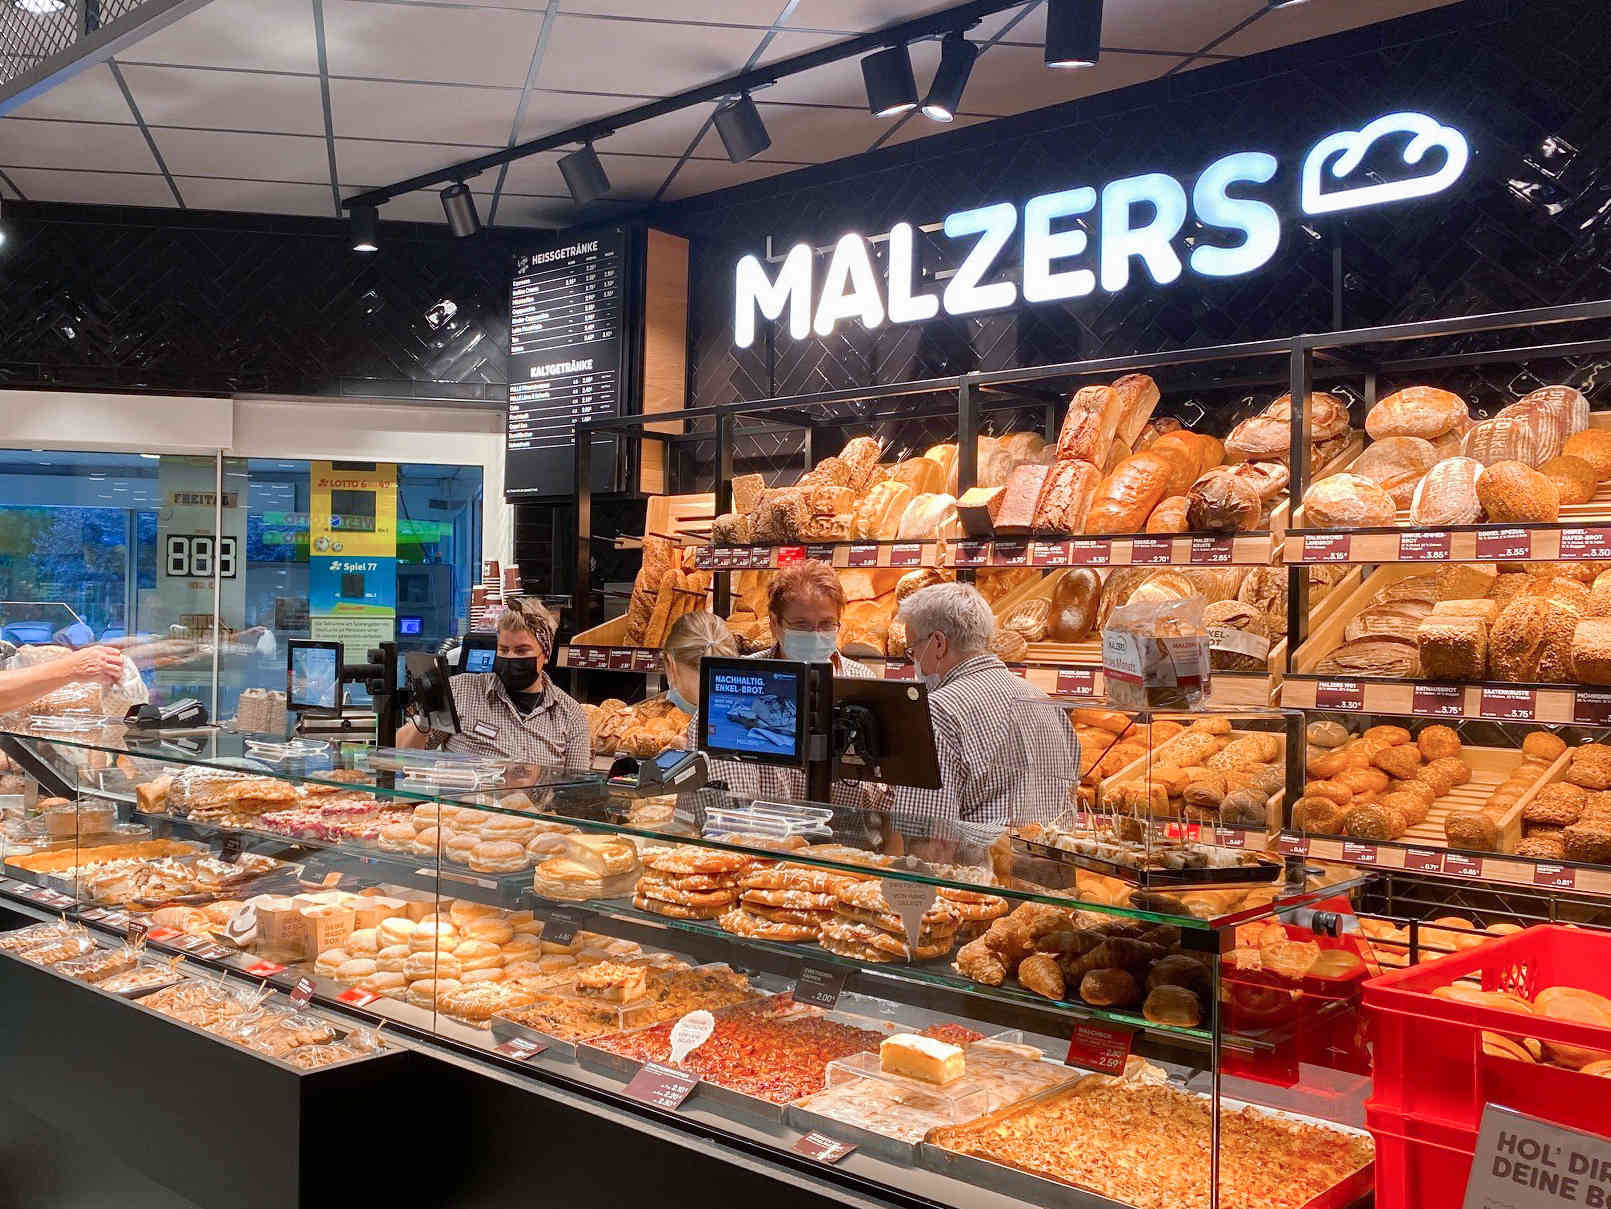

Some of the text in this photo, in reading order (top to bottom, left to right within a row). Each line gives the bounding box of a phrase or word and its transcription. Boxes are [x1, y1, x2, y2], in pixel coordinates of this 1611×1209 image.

[532, 241, 598, 265] HEISSGETRÄNKE
[735, 151, 1281, 348] MALZERS
[530, 359, 593, 378] KALTGETRÄNKE
[343, 562, 377, 573] Spiel 77
[715, 674, 766, 687] NACHHALTIG.
[715, 683, 765, 695] ENKEL-BROT.
[1497, 1130, 1561, 1168] HOL'
[1492, 1156, 1579, 1201] DEINE
